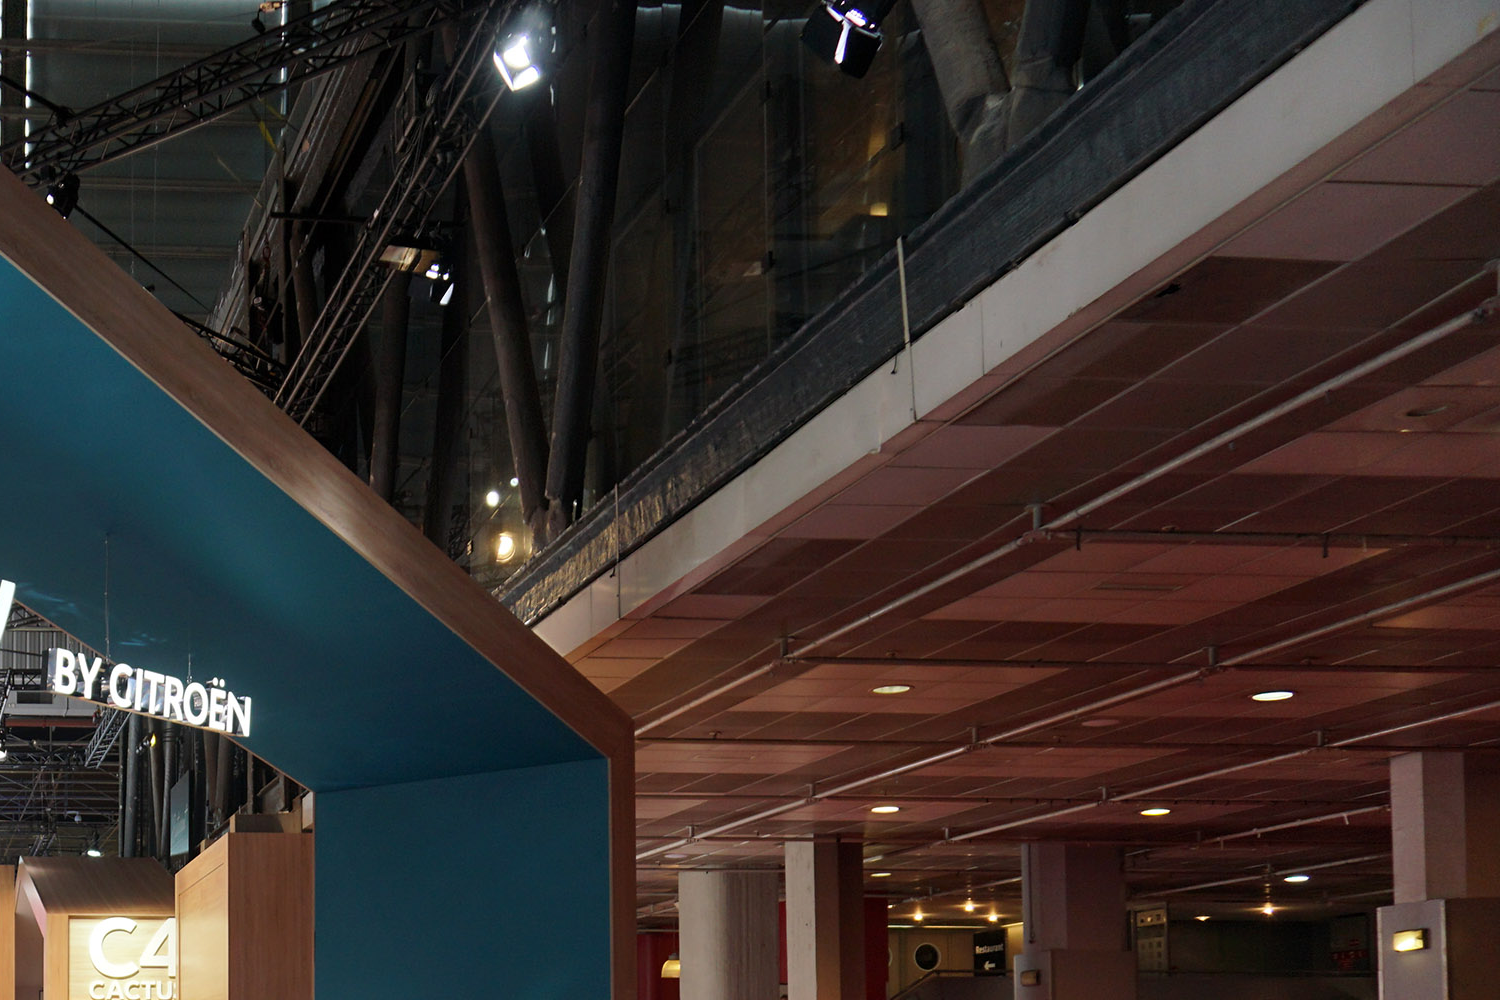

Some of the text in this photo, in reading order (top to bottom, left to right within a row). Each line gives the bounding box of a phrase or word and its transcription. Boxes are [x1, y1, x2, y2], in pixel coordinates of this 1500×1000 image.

[53, 647, 252, 738] BY CITROËN
[89, 916, 176, 979] C4
[89, 980, 176, 1000] CACTU
